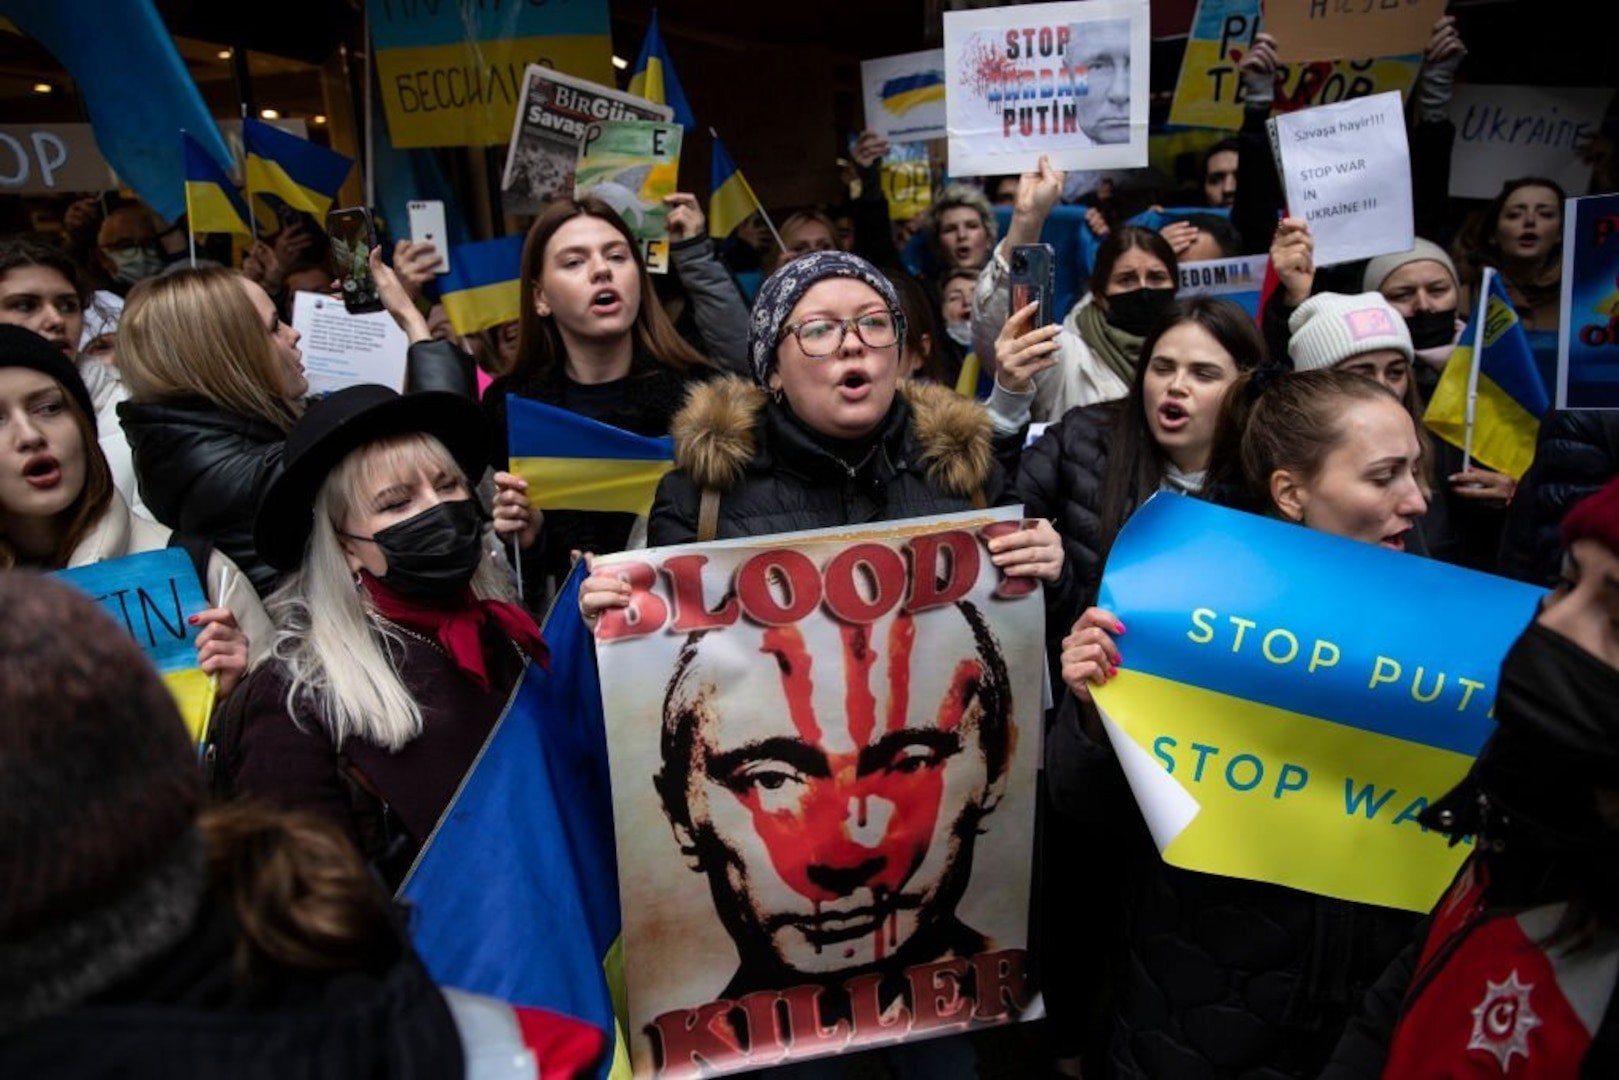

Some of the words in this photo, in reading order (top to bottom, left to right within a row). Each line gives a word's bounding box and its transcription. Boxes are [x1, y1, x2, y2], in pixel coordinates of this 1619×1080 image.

[1005, 26, 1071, 60] STOP
[1003, 99, 1078, 138] PUTİN
[1300, 166, 1332, 181] STOP
[1335, 159, 1366, 174] WAR
[1187, 607, 1340, 673] STOP
[1368, 655, 1496, 719] PUT
[1153, 736, 1309, 799] STOP
[1344, 777, 1472, 845] WA
[650, 949, 1029, 1079] KILLER
